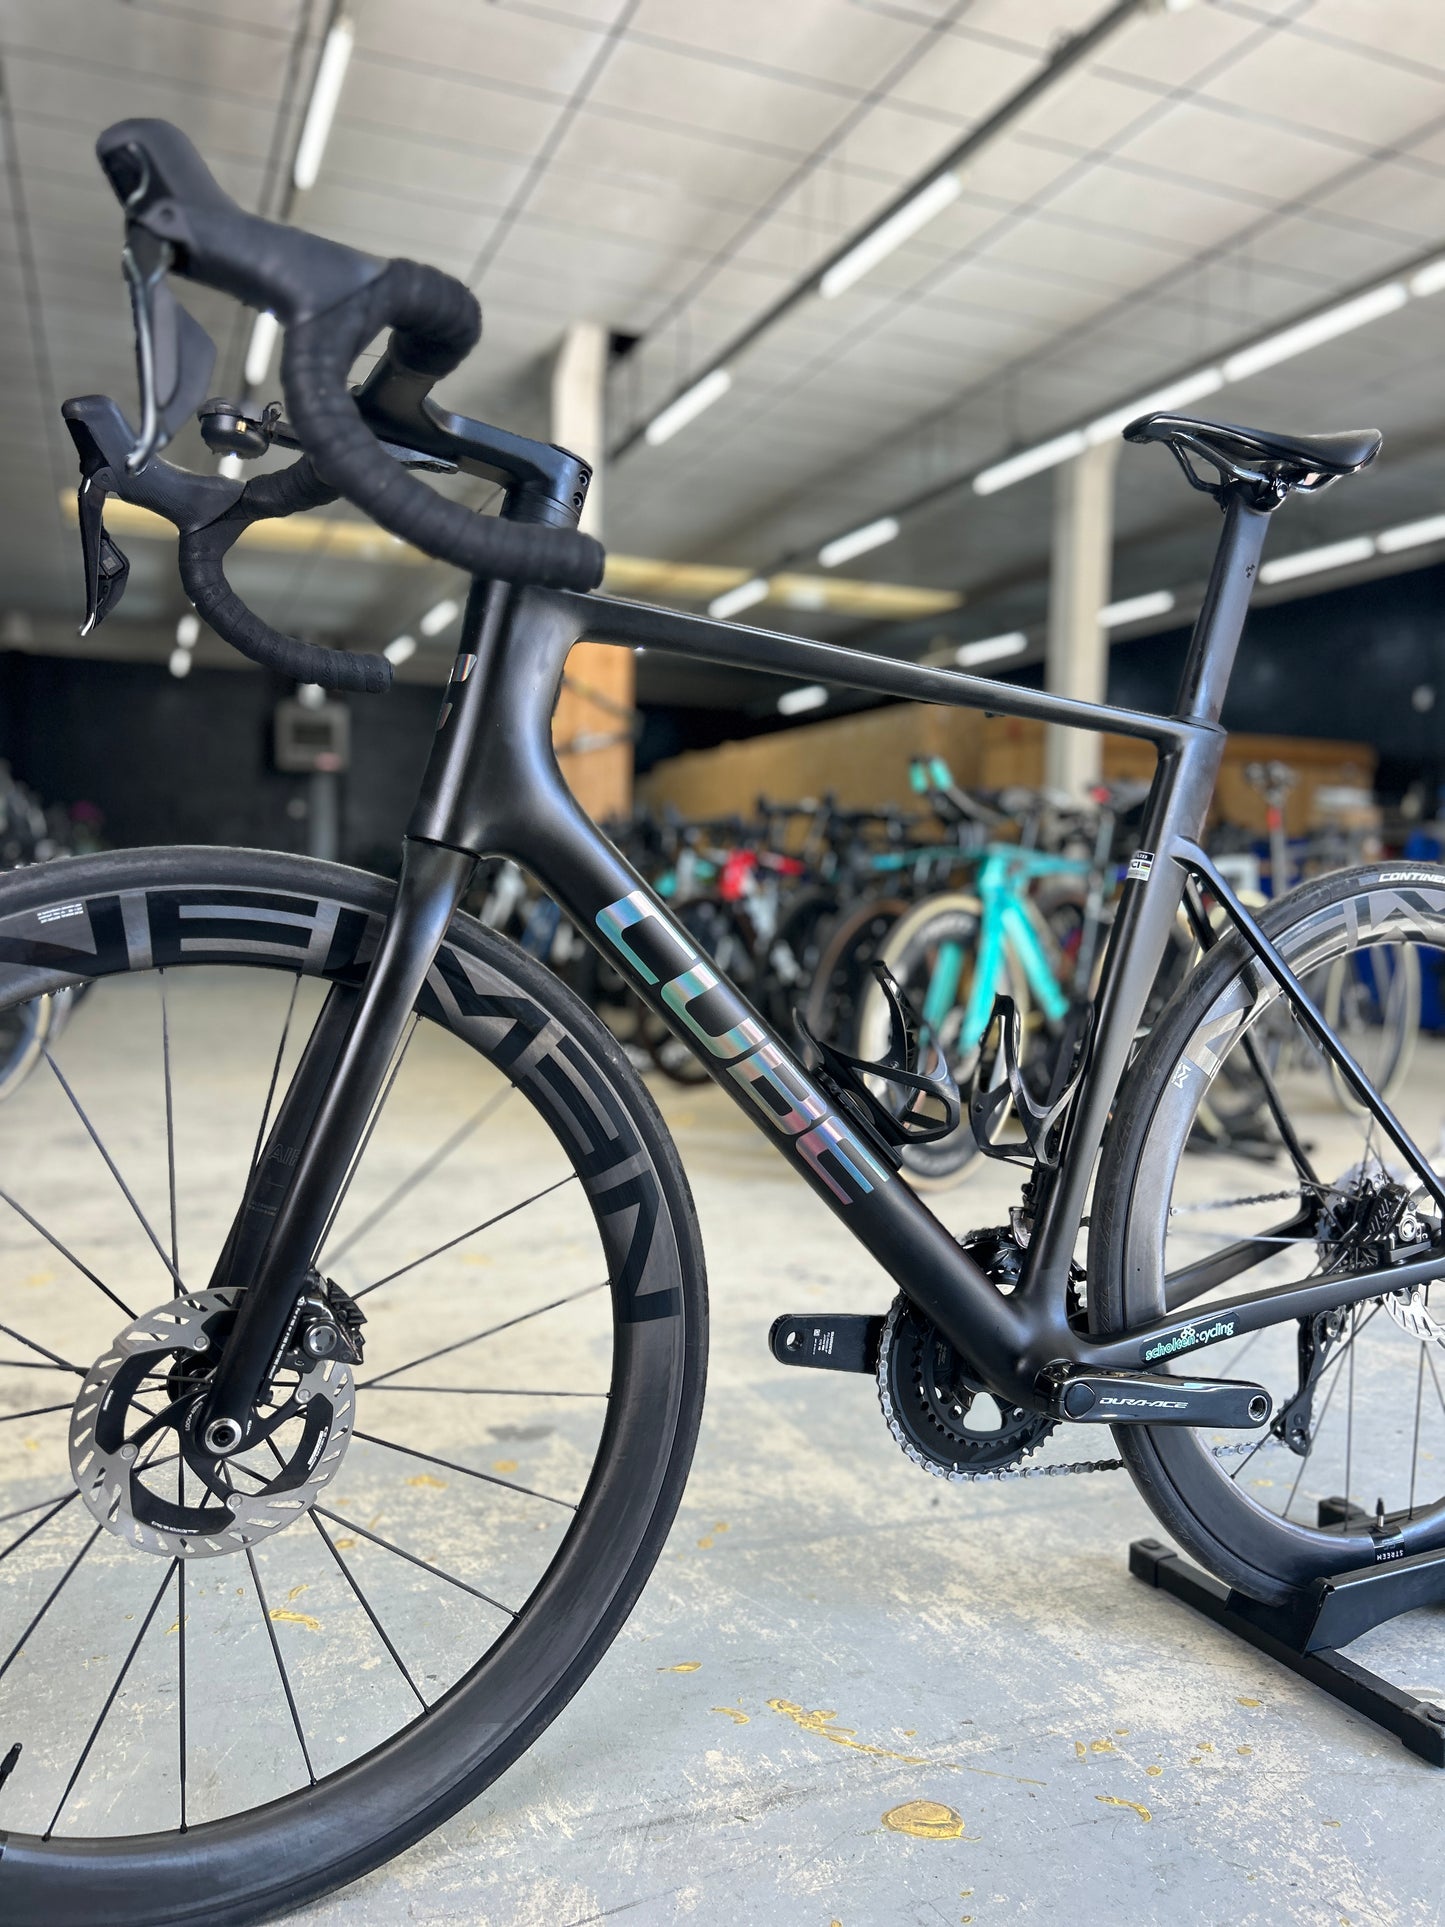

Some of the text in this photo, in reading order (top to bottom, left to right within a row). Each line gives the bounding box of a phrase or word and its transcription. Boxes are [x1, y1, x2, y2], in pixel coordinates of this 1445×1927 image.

[1378, 871, 1445, 884] CONTINE
[595, 890, 890, 1206] CUBE
[1099, 1396, 1189, 1409] DURA-ACE
